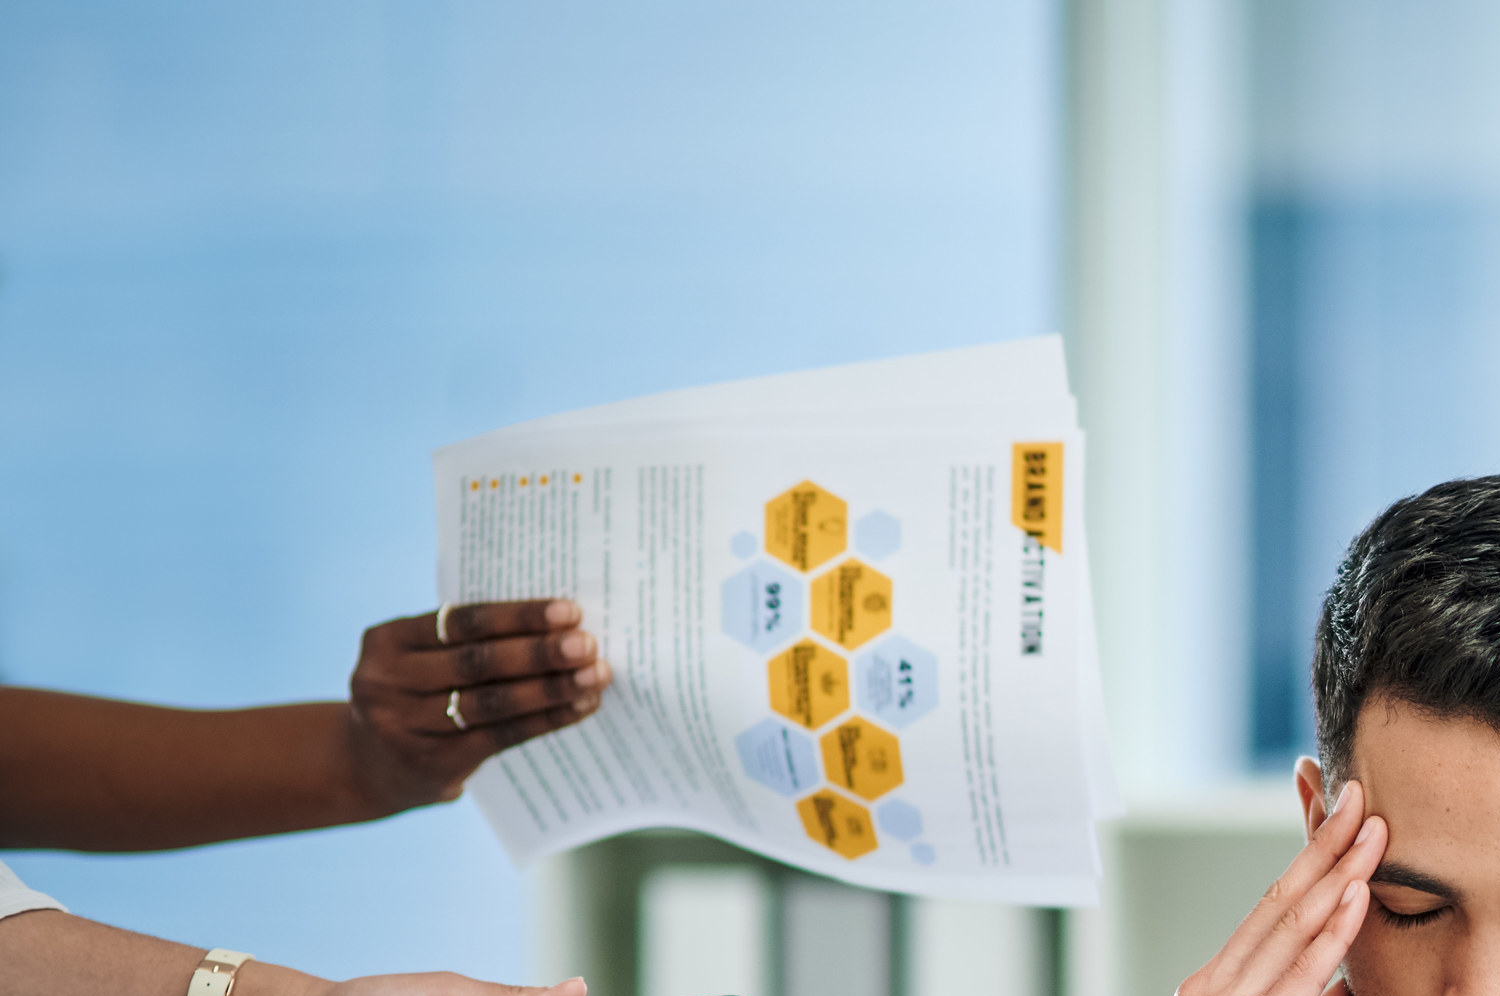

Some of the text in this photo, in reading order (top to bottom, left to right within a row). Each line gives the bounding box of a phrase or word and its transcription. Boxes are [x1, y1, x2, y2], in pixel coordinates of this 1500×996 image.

[1021, 451, 1045, 656] BRAND ACTIVATION
[765, 583, 782, 632] 99%
[898, 659, 912, 708] 41%
